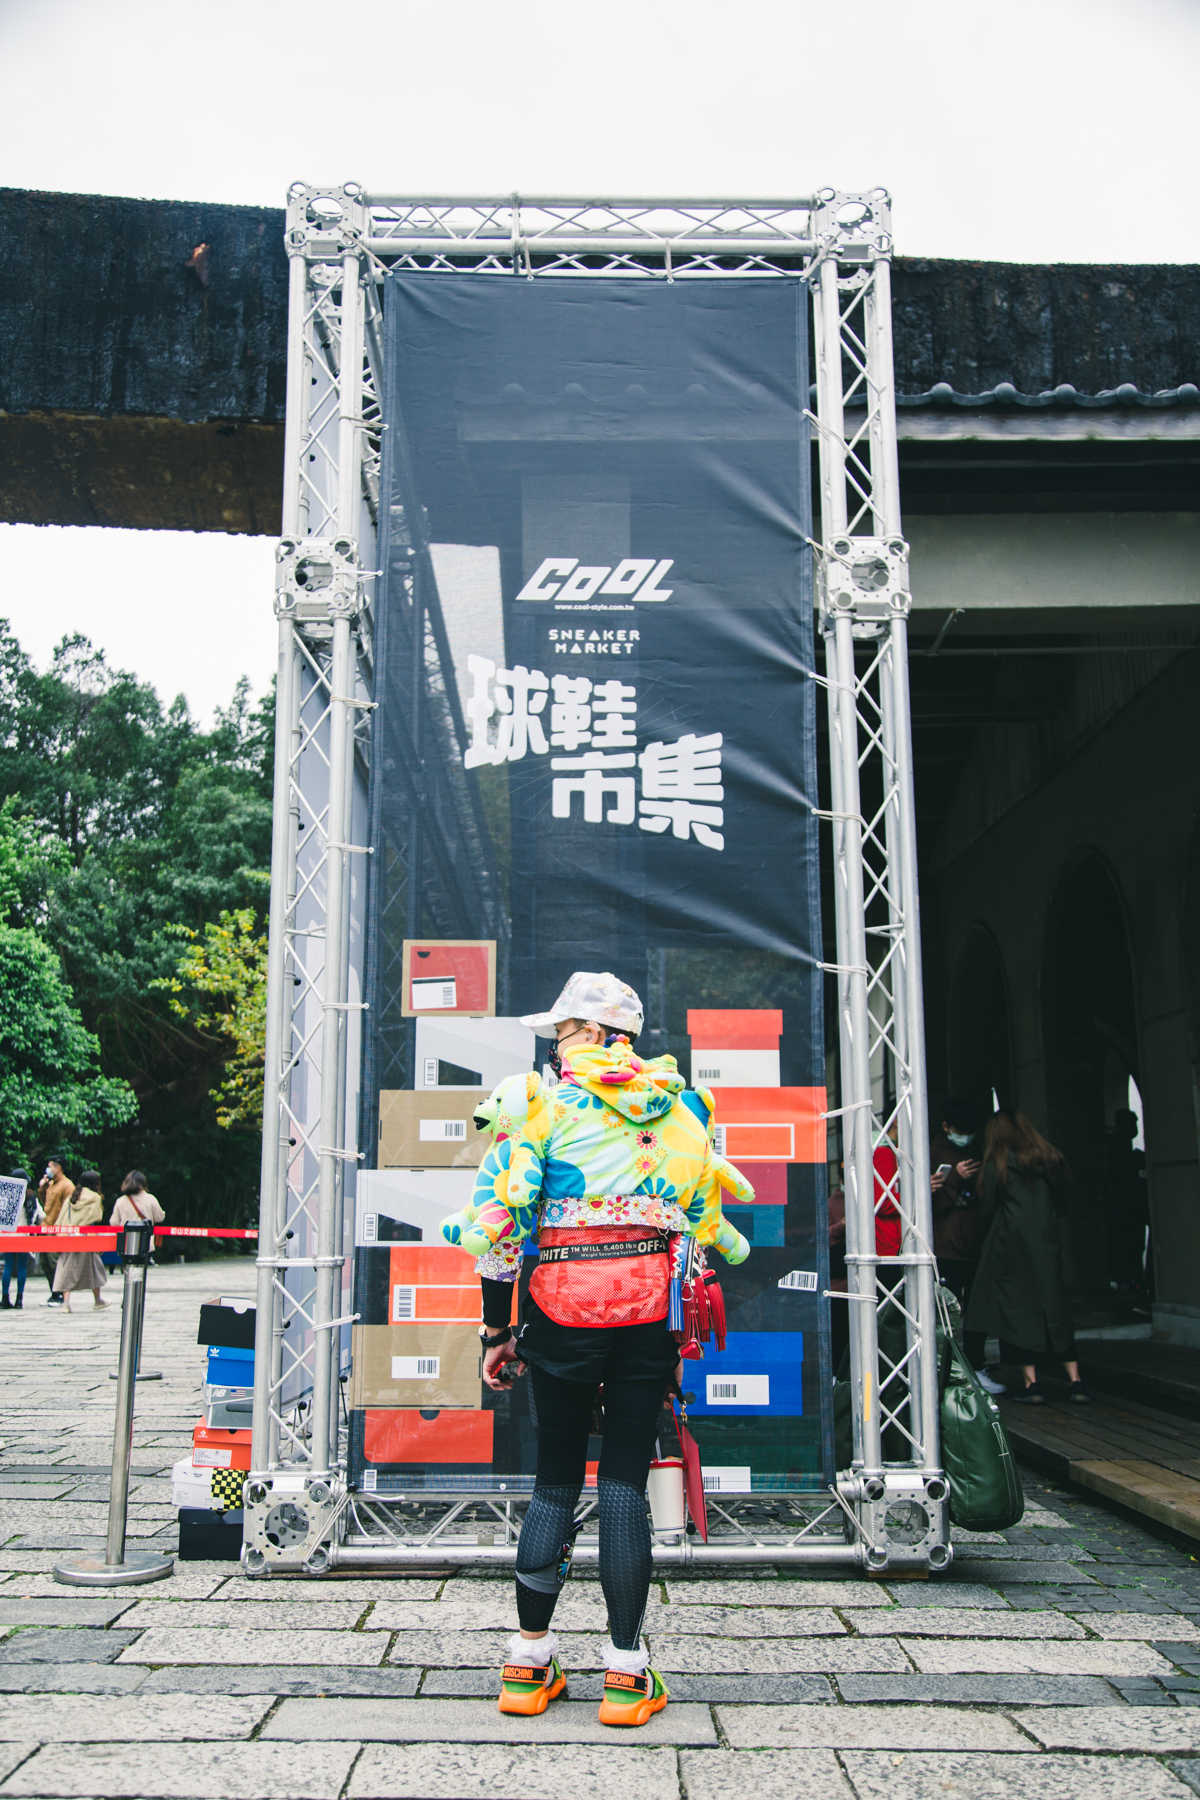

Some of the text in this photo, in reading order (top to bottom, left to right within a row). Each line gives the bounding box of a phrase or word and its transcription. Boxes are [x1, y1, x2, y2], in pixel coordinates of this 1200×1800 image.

[548, 629, 640, 641] SNEAKER
[555, 642, 634, 654] MARKET
[604, 1243, 624, 1251] 5,400
